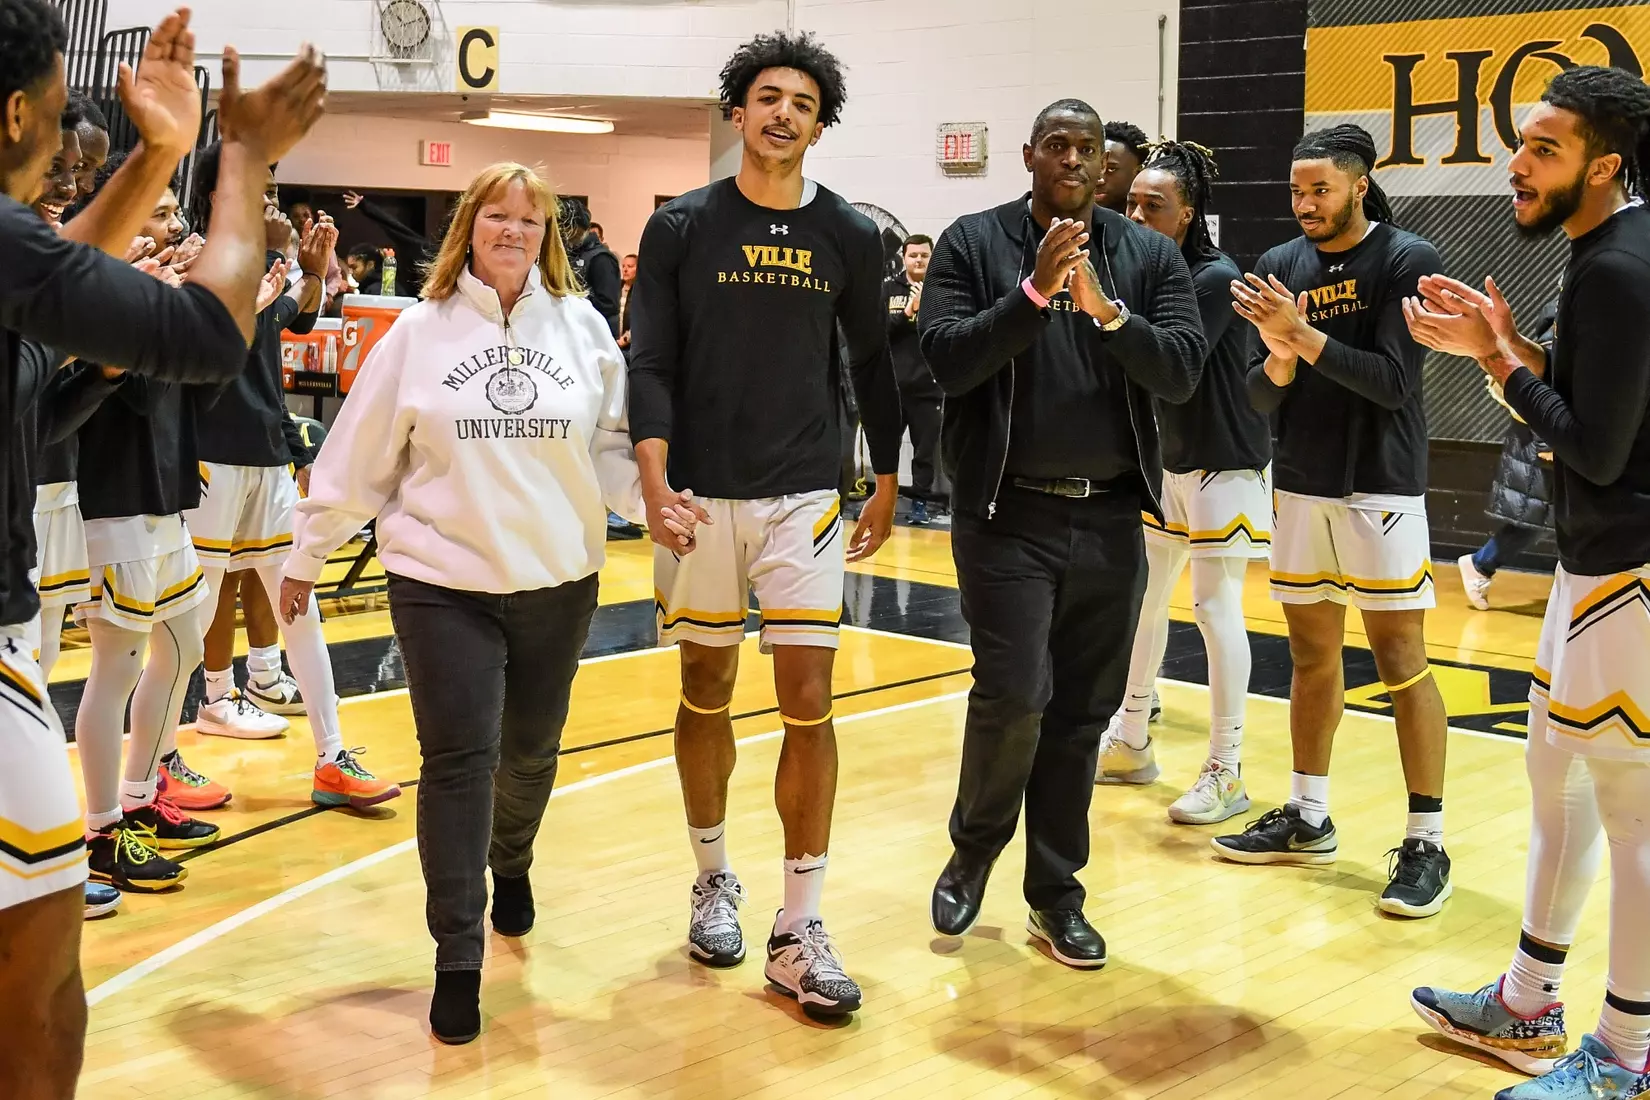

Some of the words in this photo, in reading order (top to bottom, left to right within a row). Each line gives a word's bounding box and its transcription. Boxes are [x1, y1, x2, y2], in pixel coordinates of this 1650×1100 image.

[458, 28, 495, 88] C
[429, 142, 451, 163] EXIT
[742, 244, 812, 275] VILLE
[717, 271, 831, 292] BASKETBALL
[1308, 279, 1357, 308] VILLE
[343, 320, 358, 347] G
[455, 418, 572, 440] UNIVERSITY
